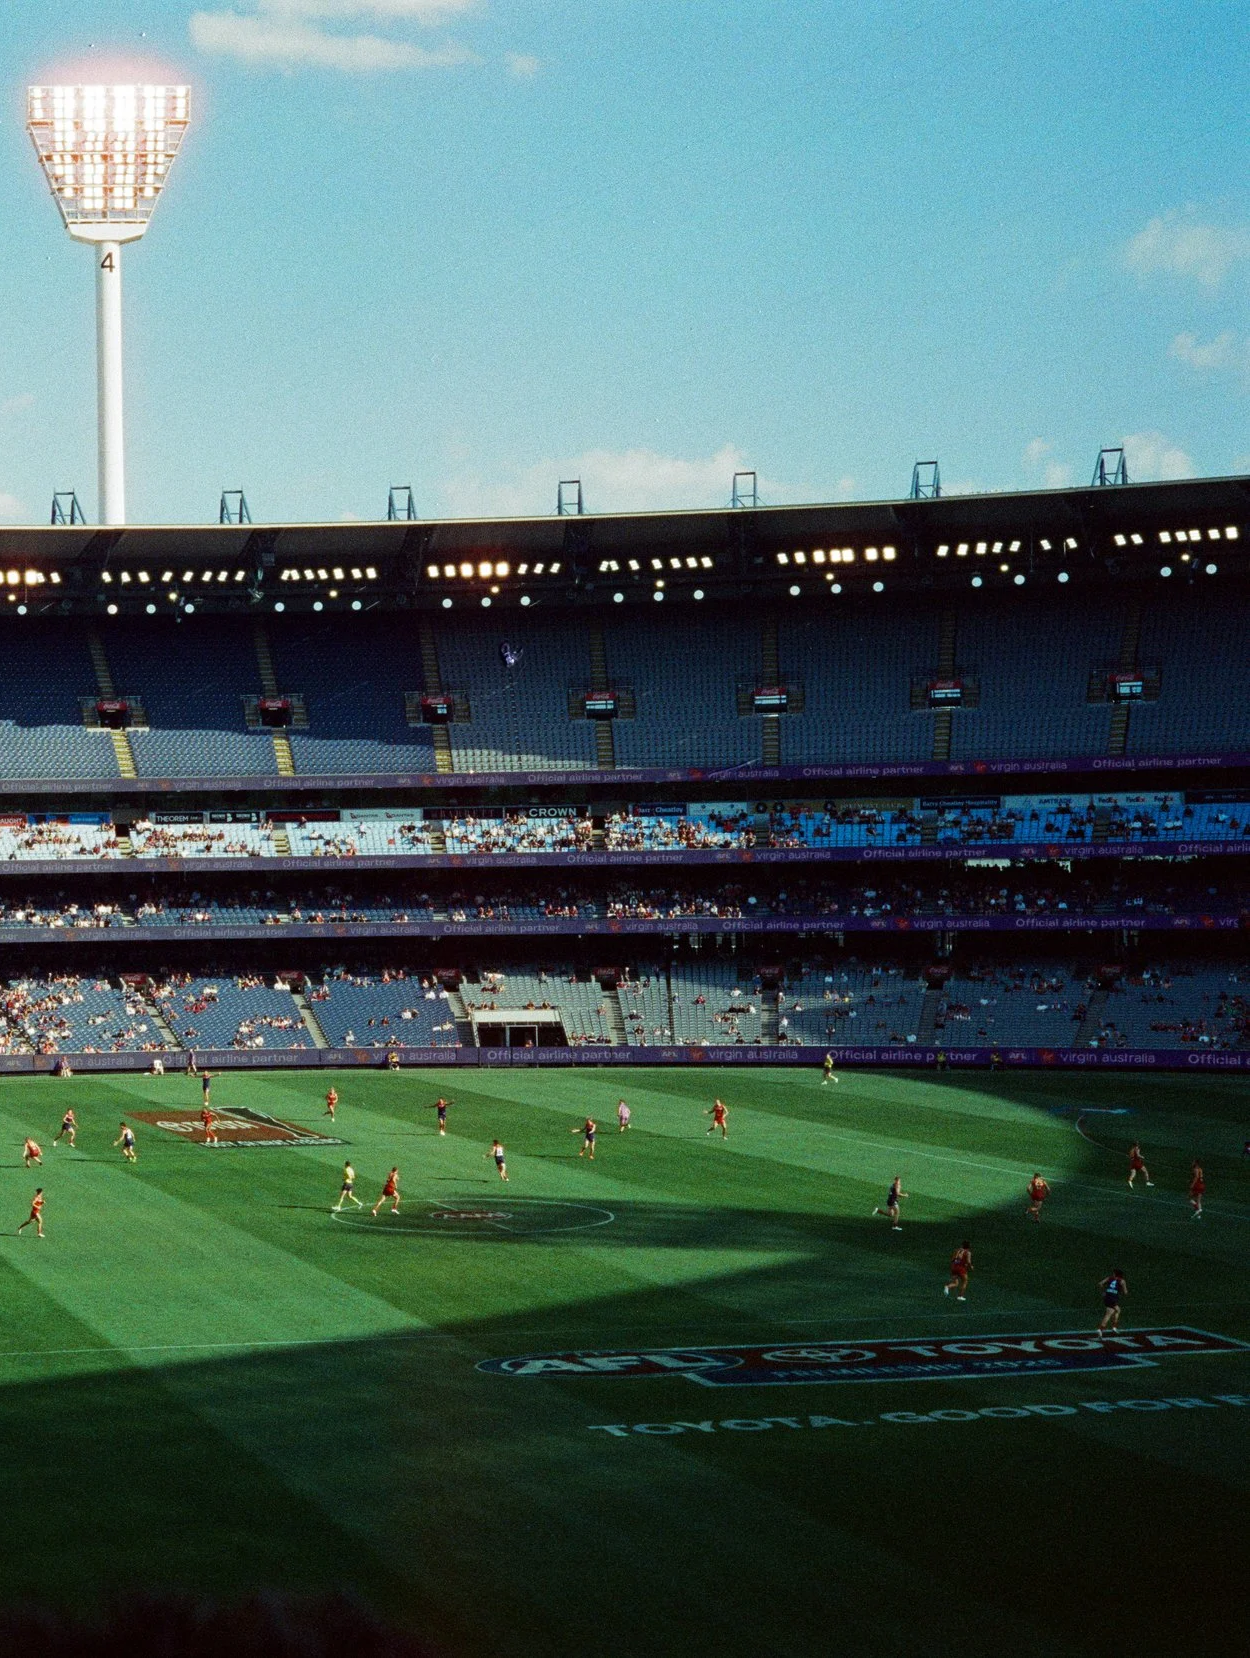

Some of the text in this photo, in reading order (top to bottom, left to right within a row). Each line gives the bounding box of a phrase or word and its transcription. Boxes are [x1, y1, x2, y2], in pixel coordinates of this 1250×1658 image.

[100, 252, 115, 273] 4
[990, 761, 1067, 773] virgin australia
[1092, 757, 1222, 768] Official airline partner
[737, 768, 779, 777] australia
[802, 765, 923, 776] Official airline partner
[263, 777, 374, 787] Official airline partner
[434, 775, 504, 786] virgin australia
[527, 772, 642, 782] Official airline partner
[1, 782, 40, 790] Official
[202, 779, 242, 788] australia
[529, 807, 577, 817] CROWN
[862, 847, 987, 857] Official airline partner
[1063, 844, 1143, 855] virgin australia
[1177, 843, 1222, 852] Official
[464, 855, 537, 866] virgin australia
[567, 853, 683, 863] Official airline partner
[755, 849, 831, 861] virgin australia
[1, 863, 39, 872] Official
[75, 862, 112, 872] partner
[182, 859, 252, 870] virgin australia
[282, 858, 394, 868] Official airline partner
[443, 923, 560, 934] Official airline partner
[626, 921, 699, 932] virgin australia
[722, 920, 844, 930] Official airline partner
[913, 918, 990, 929] virgin australia
[1015, 918, 1145, 928] Official airline partner
[173, 928, 287, 938] Official airline partner
[350, 925, 420, 936] virgin australia
[91, 1055, 134, 1065] australia
[210, 1053, 298, 1064] airline partner
[408, 1050, 456, 1059] australia
[487, 1050, 630, 1061] Official airline partner
[708, 1049, 798, 1060] virgin australia
[828, 1050, 920, 1059] Official airline
[1059, 1052, 1155, 1063] virgin australia
[1188, 1054, 1240, 1063] Official
[888, 1335, 1207, 1357] TOYOTA
[515, 1353, 727, 1374] AFL
[879, 1404, 1078, 1423] GOOD
[1078, 1397, 1223, 1413] FOR
